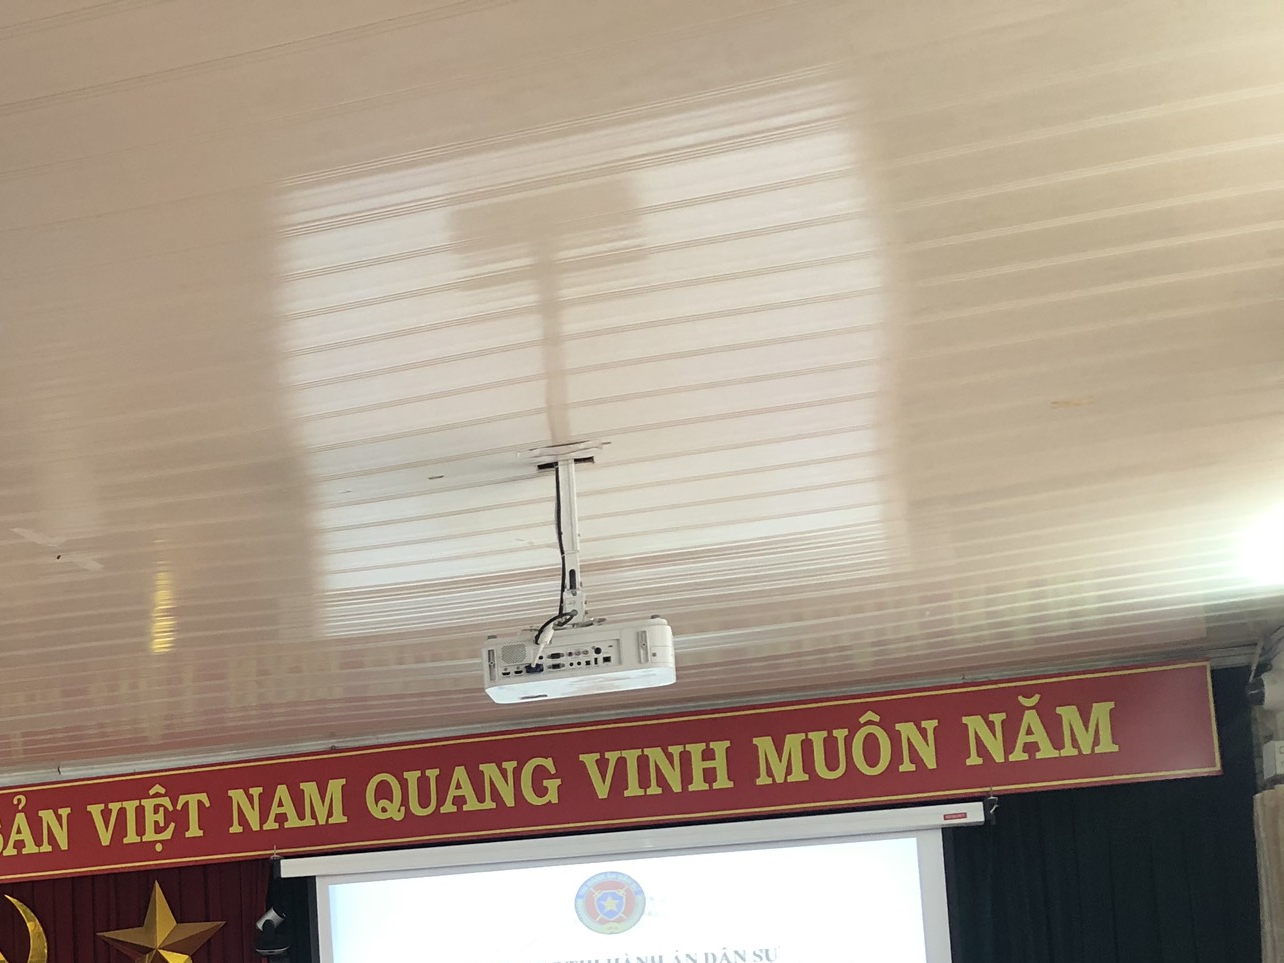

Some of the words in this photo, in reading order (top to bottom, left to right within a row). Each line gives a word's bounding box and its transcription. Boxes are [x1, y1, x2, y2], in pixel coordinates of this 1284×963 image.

[87, 783, 210, 852] VIỆT
[228, 778, 348, 834] NAM
[365, 757, 562, 821] QUANG
[580, 739, 734, 800] VINH
[752, 710, 939, 786] MUÔN
[961, 693, 1120, 766] NĂM
